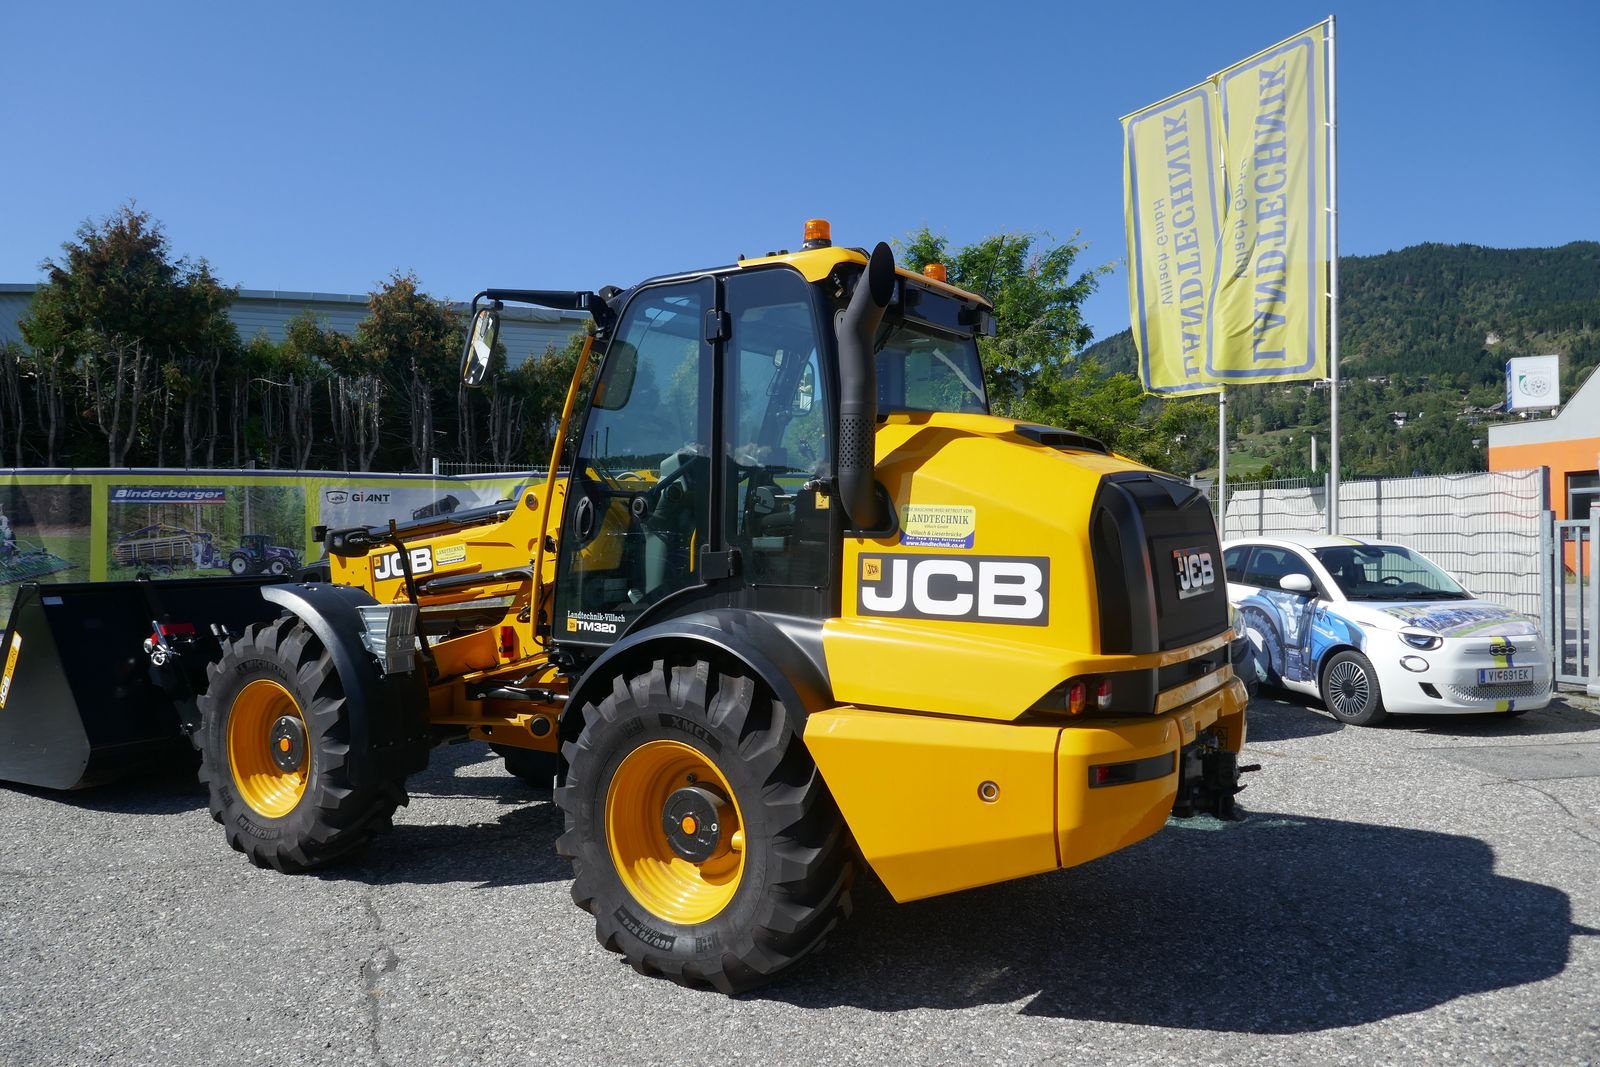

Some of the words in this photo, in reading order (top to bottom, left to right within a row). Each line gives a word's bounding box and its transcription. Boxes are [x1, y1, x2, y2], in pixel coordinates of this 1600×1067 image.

[115, 489, 222, 499] Binderberger
[905, 514, 968, 524] LANDTECHNIK
[374, 548, 432, 579] JCB
[1178, 553, 1215, 590] JCB
[862, 559, 1044, 620] JCB
[577, 621, 616, 633] TM320
